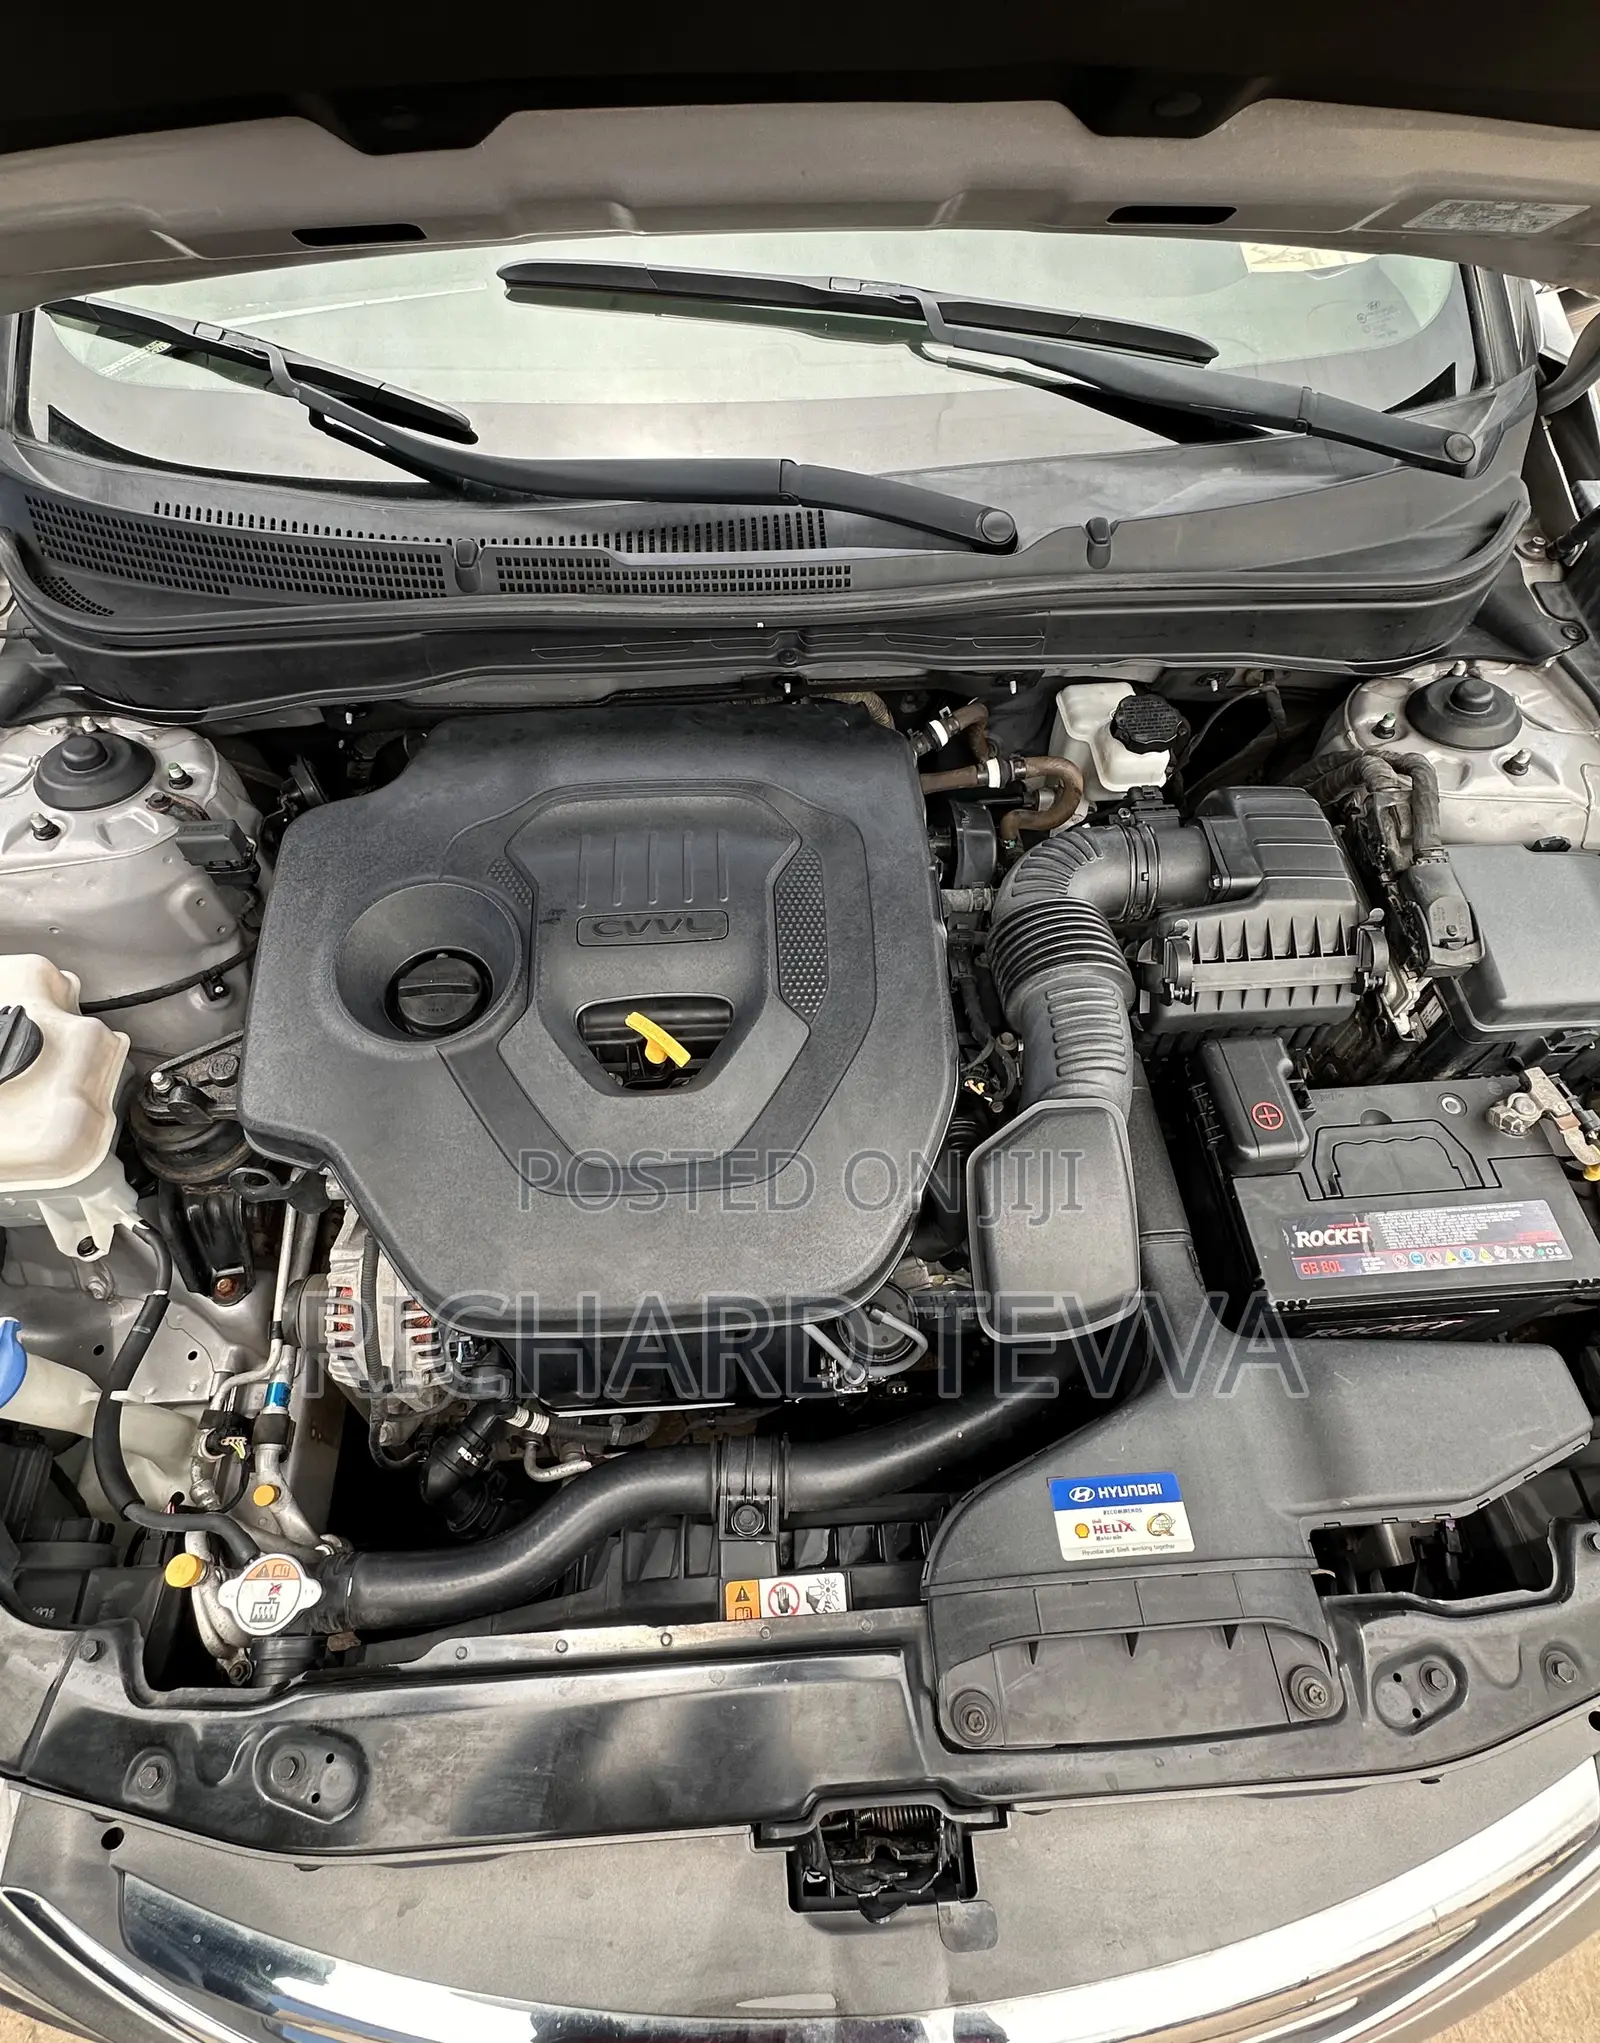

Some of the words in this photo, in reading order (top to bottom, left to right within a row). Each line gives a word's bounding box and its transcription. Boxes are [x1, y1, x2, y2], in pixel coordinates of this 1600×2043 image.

[592, 917, 713, 938] CVVL
[1294, 1226, 1371, 1248] ROCKET
[1300, 1261, 1320, 1275] GB
[1321, 1259, 1346, 1274] 80L
[1304, 1319, 1466, 1339] ROCKET
[1098, 1483, 1163, 1499] HYUNDAI
[1093, 1520, 1136, 1535] HELIX
